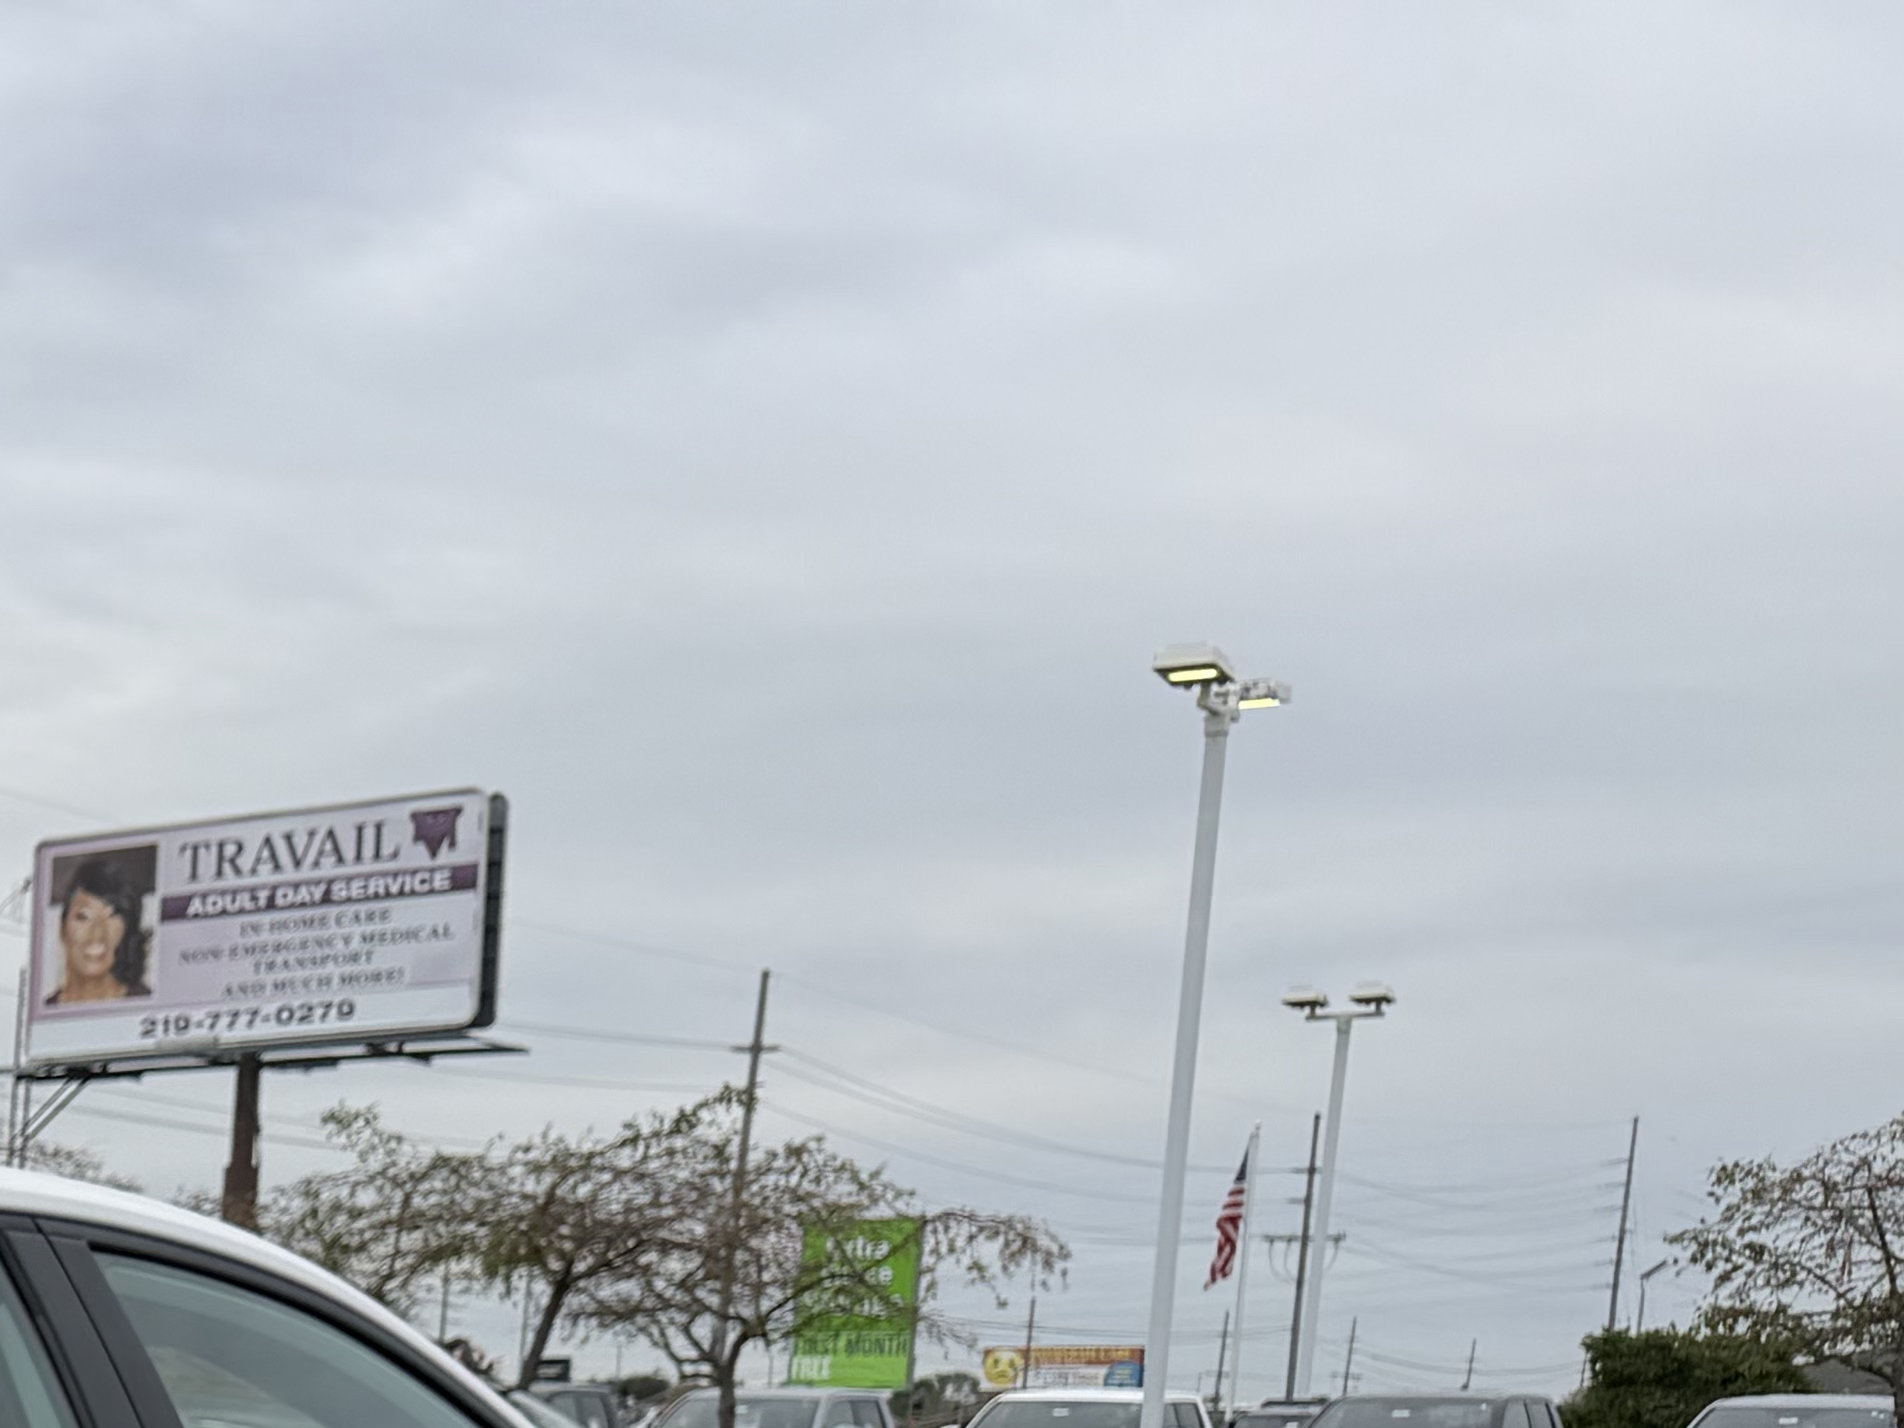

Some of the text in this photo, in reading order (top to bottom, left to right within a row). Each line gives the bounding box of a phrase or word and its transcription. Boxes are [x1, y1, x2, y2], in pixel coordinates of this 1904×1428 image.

[178, 820, 400, 883] TRAVAIL
[185, 868, 452, 917] ADULT DAY SERVICE
[268, 914, 329, 933] HOME
[335, 907, 391, 928] CARE
[359, 921, 455, 946] MEDICAL
[253, 950, 375, 976] TRANSPORT
[221, 982, 267, 1000] AND
[272, 973, 333, 994] MUCH
